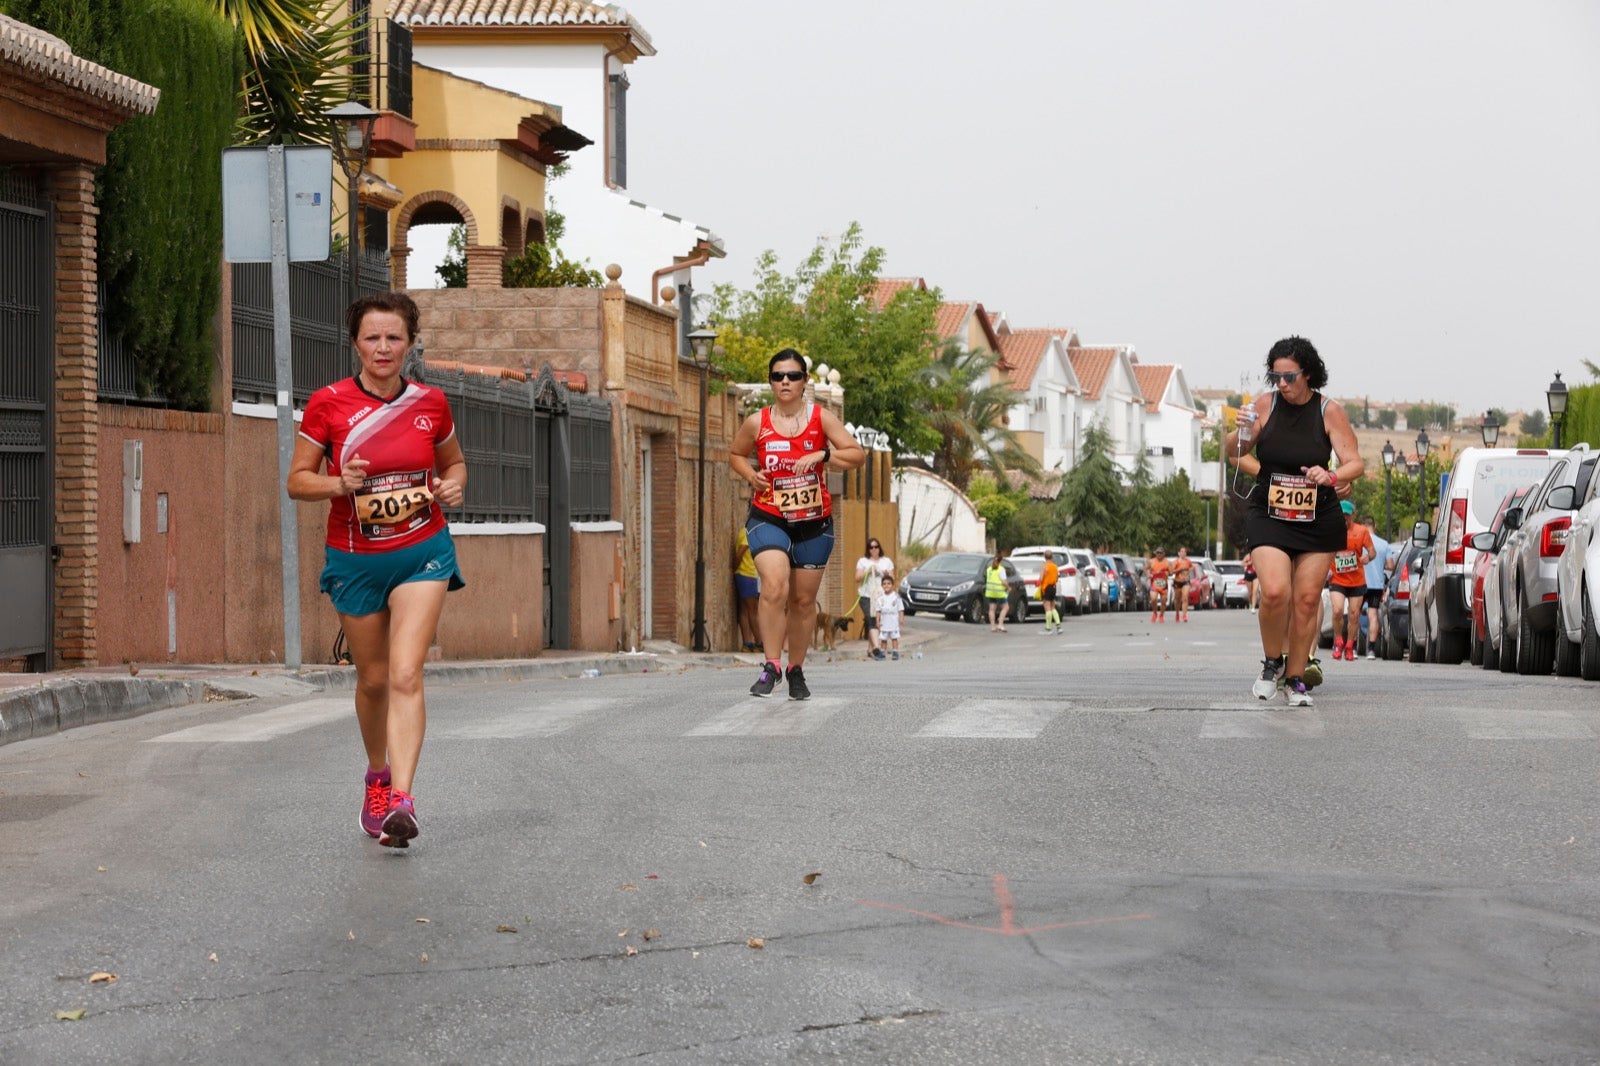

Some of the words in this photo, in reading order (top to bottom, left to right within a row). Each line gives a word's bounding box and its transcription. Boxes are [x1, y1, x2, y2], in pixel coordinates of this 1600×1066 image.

[781, 488, 818, 507] 2137
[1275, 489, 1313, 506] 2104
[1339, 557, 1354, 567] 704
